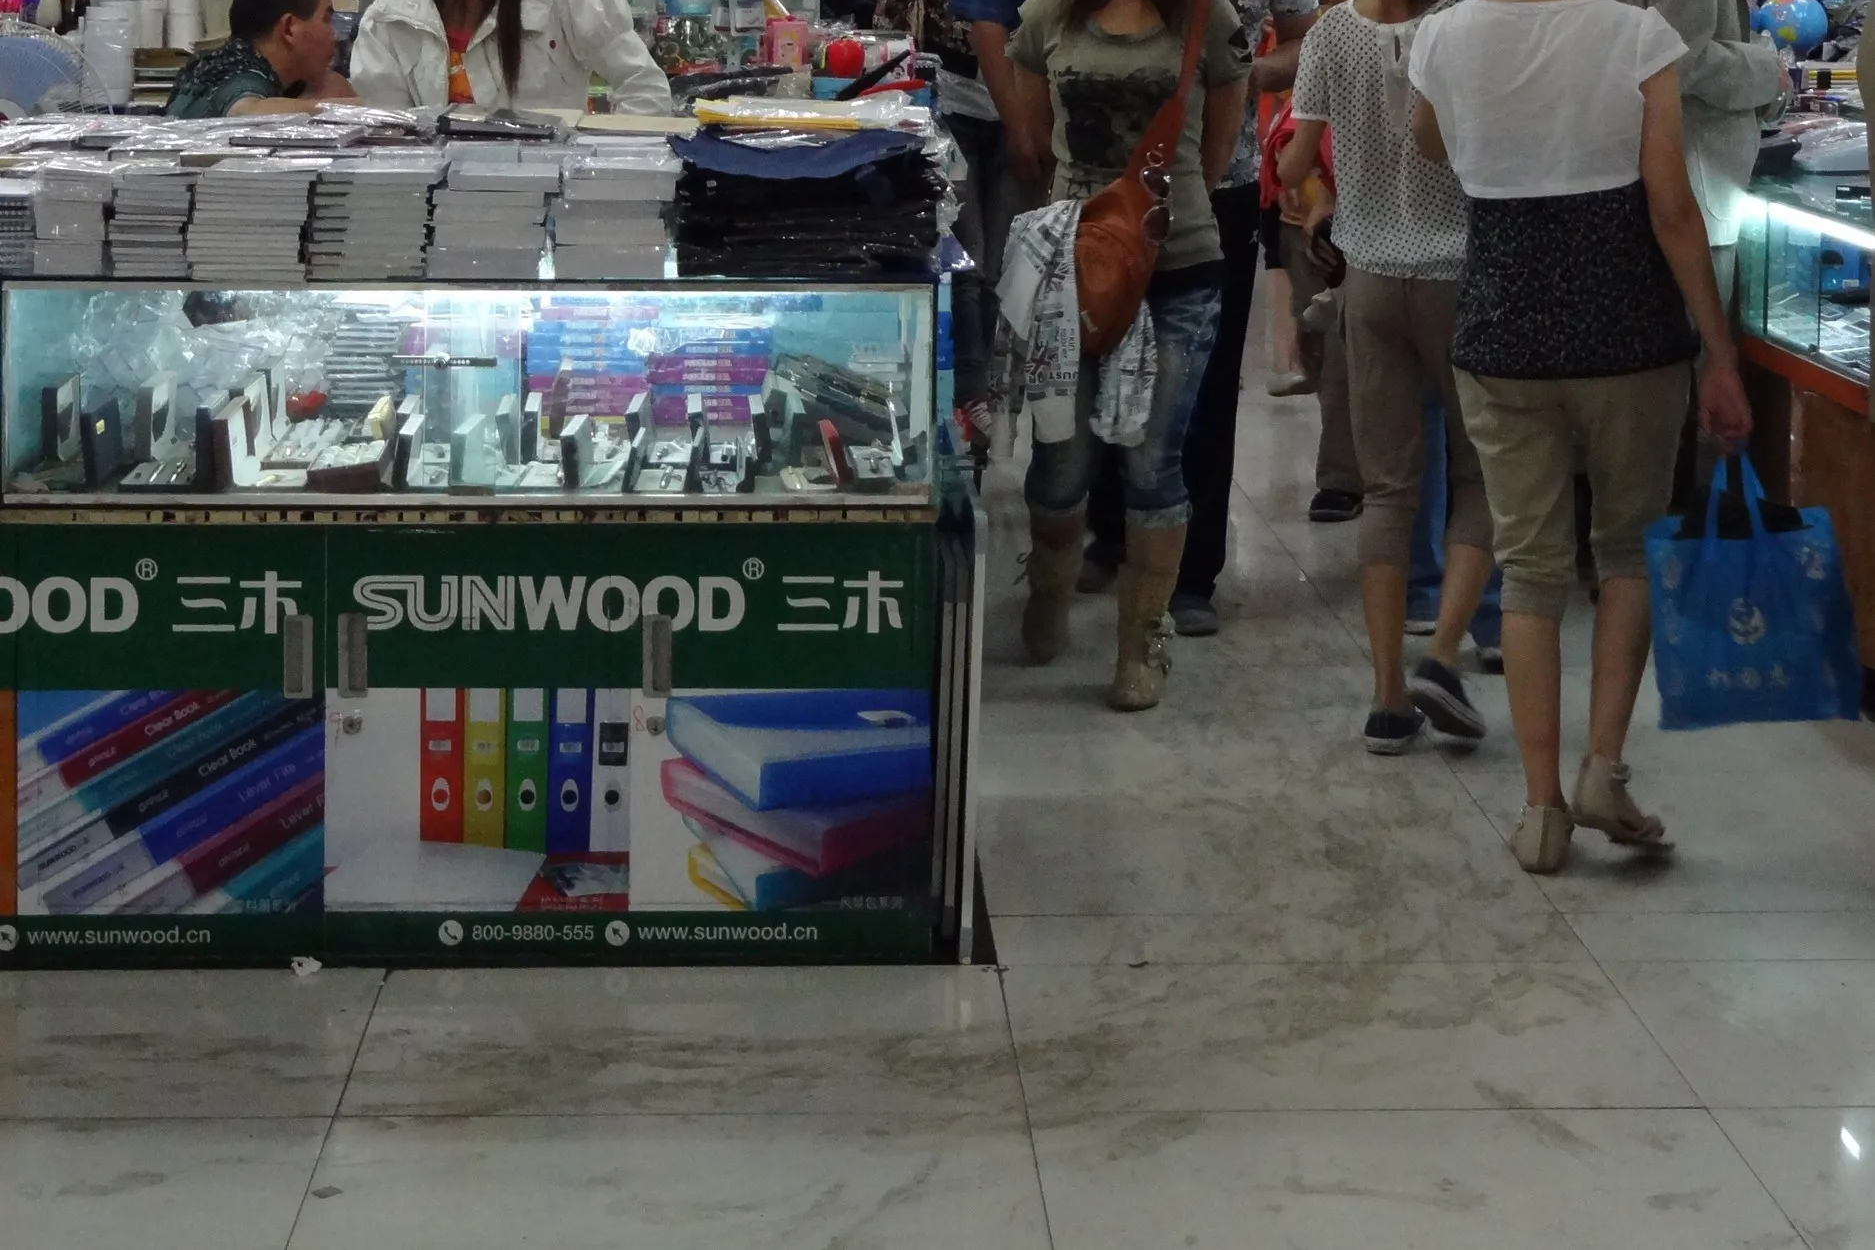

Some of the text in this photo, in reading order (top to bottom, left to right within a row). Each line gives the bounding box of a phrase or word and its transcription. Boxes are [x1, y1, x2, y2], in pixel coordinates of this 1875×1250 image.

[172, 571, 302, 634] 三木
[353, 575, 745, 632] SUNWOOD
[777, 571, 904, 633] 三木
[198, 738, 258, 777] Clear Book
[27, 925, 211, 945] www.sunwood.cn
[472, 923, 818, 941] 800-9880-555 www.sunwood.cn
